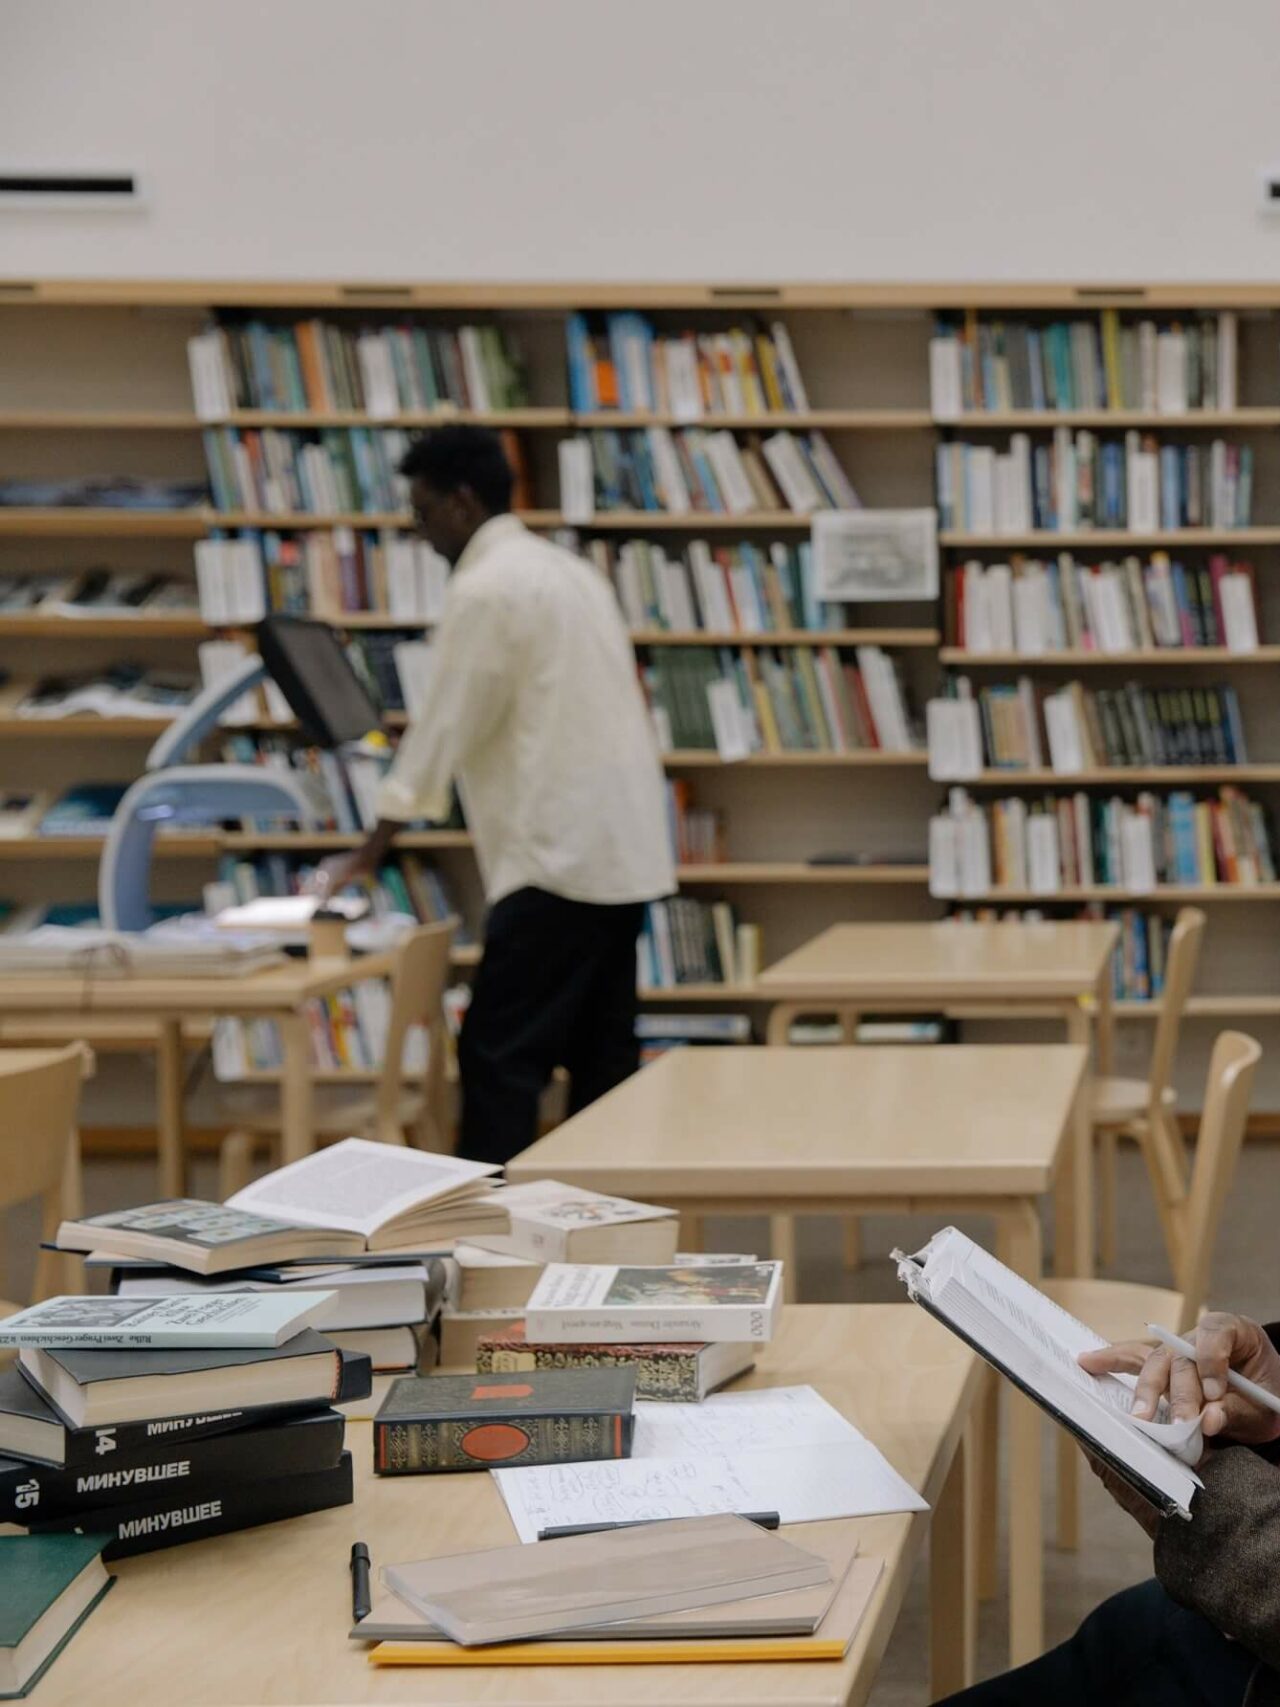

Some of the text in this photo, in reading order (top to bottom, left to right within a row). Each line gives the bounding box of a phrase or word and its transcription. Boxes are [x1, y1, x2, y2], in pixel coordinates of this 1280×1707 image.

[21, 1335, 74, 1344] Geschichten
[75, 1333, 102, 1344] Prager
[104, 1335, 124, 1344] Zwei
[129, 1335, 152, 1344] Rilke
[77, 1460, 191, 1493] МИНУВШЕЕ
[15, 1479, 40, 1509] 15
[118, 1500, 222, 1540] МИНУВШЕЕ
